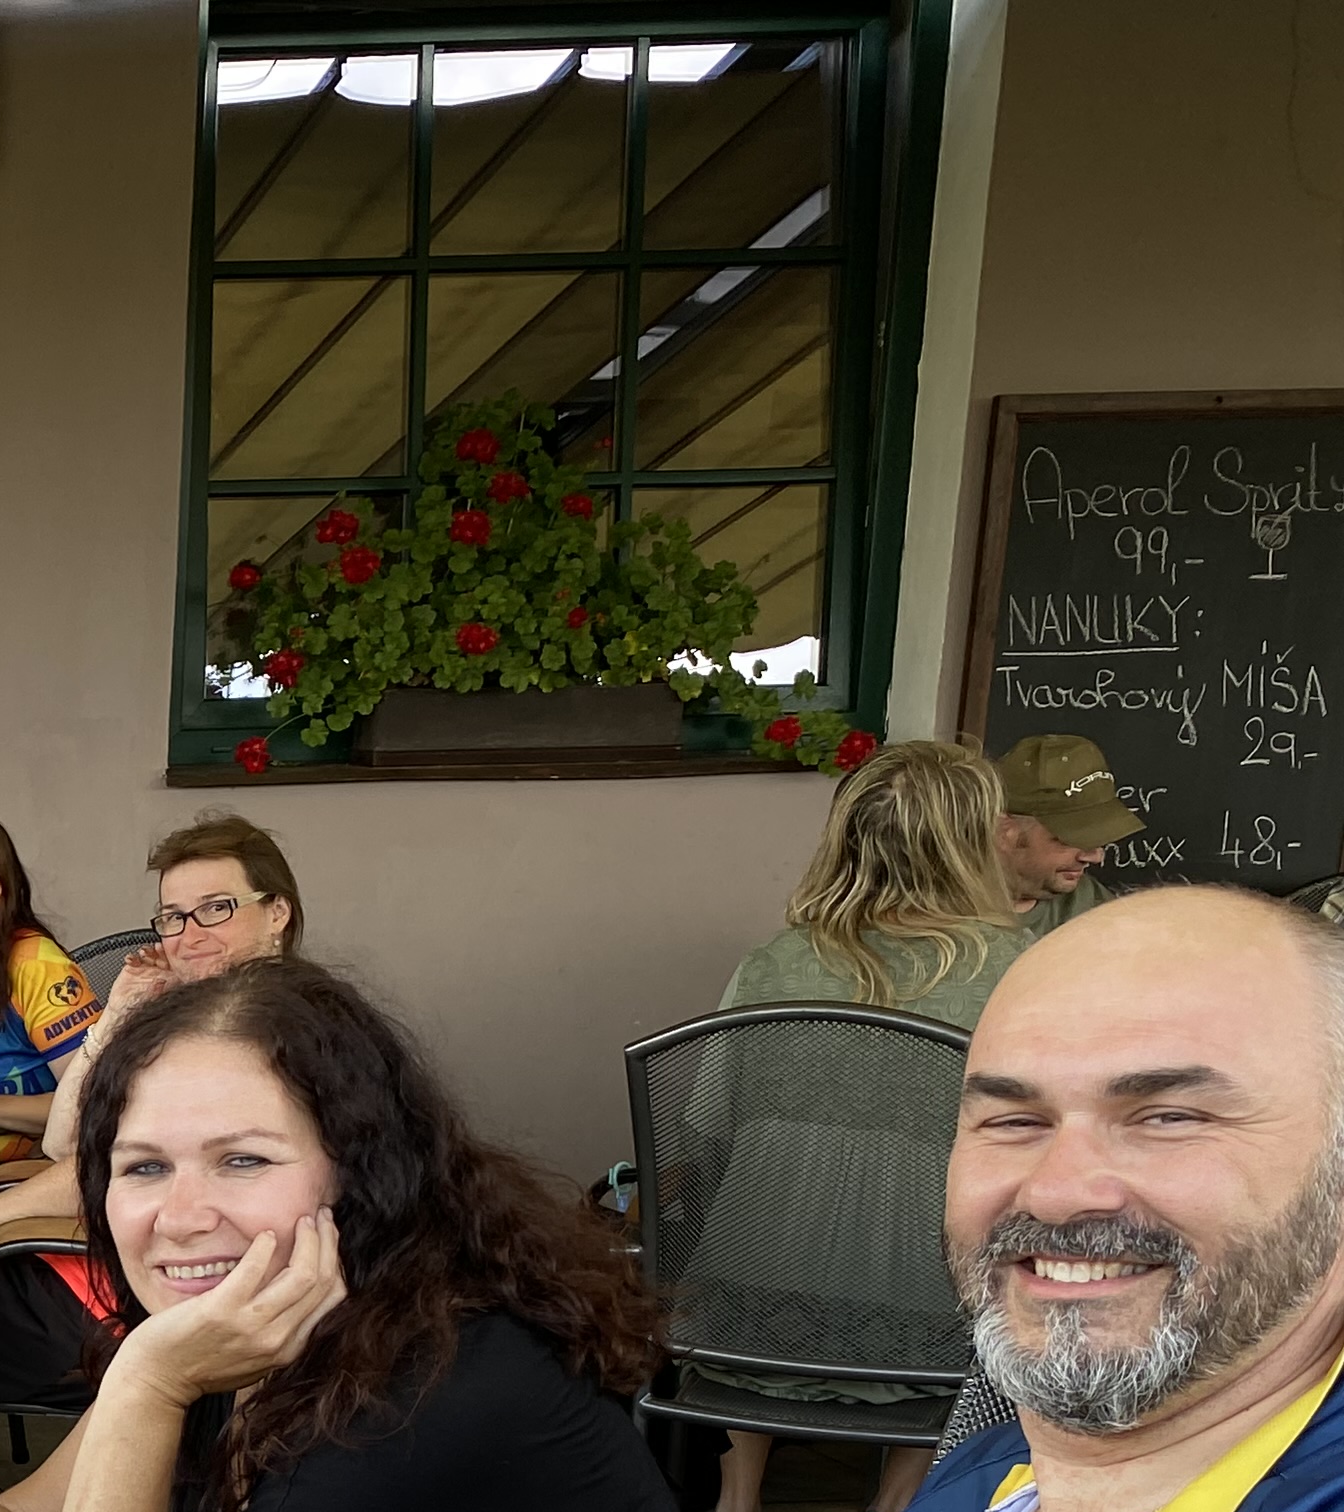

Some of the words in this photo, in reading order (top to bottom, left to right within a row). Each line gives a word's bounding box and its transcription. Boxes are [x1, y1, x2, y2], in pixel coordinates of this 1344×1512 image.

[1021, 445, 1192, 540] Aperol
[1008, 593, 1203, 647] NANUKY:
[1222, 640, 1328, 718] MÍŠA
